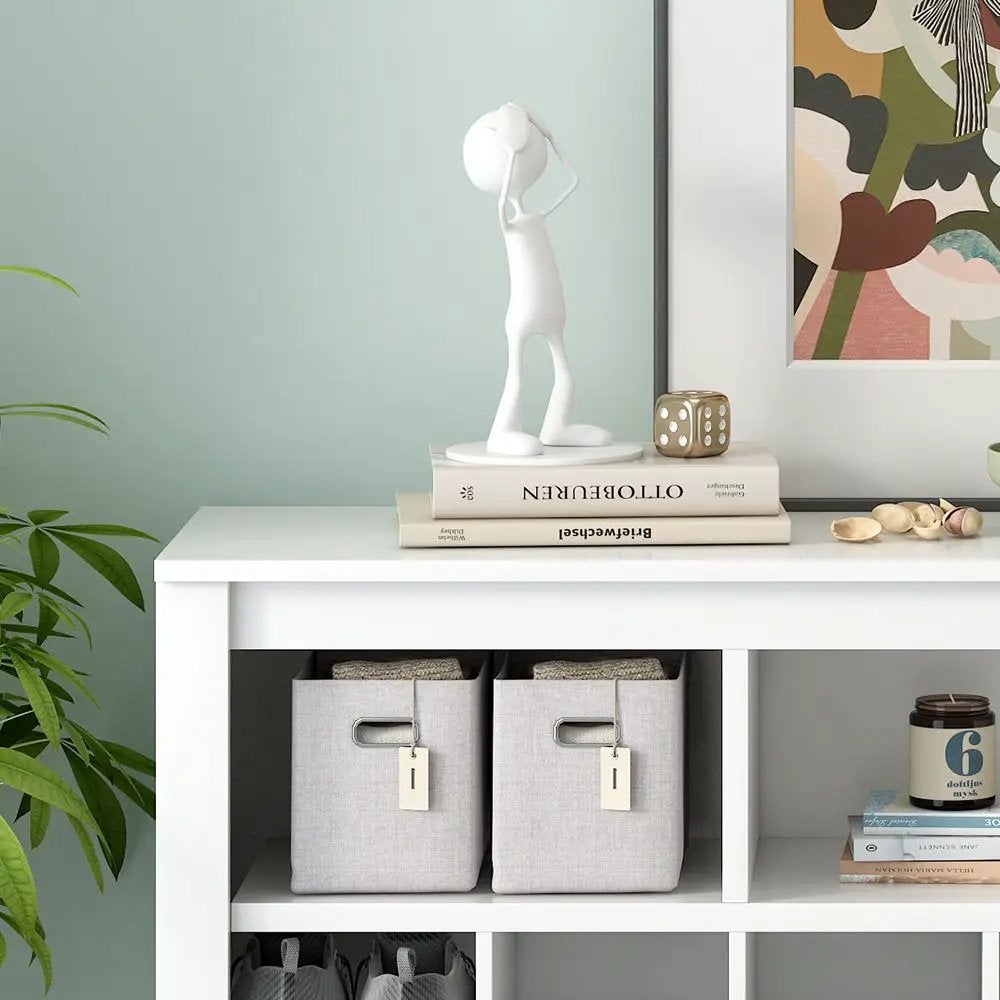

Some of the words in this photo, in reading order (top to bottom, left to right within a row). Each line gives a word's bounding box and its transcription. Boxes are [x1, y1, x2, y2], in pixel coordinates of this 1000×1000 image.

[523, 484, 683, 500] OTTOBEUREN
[559, 528, 652, 541] Briefwechsel
[944, 729, 984, 776] 6
[953, 789, 979, 799] mysk
